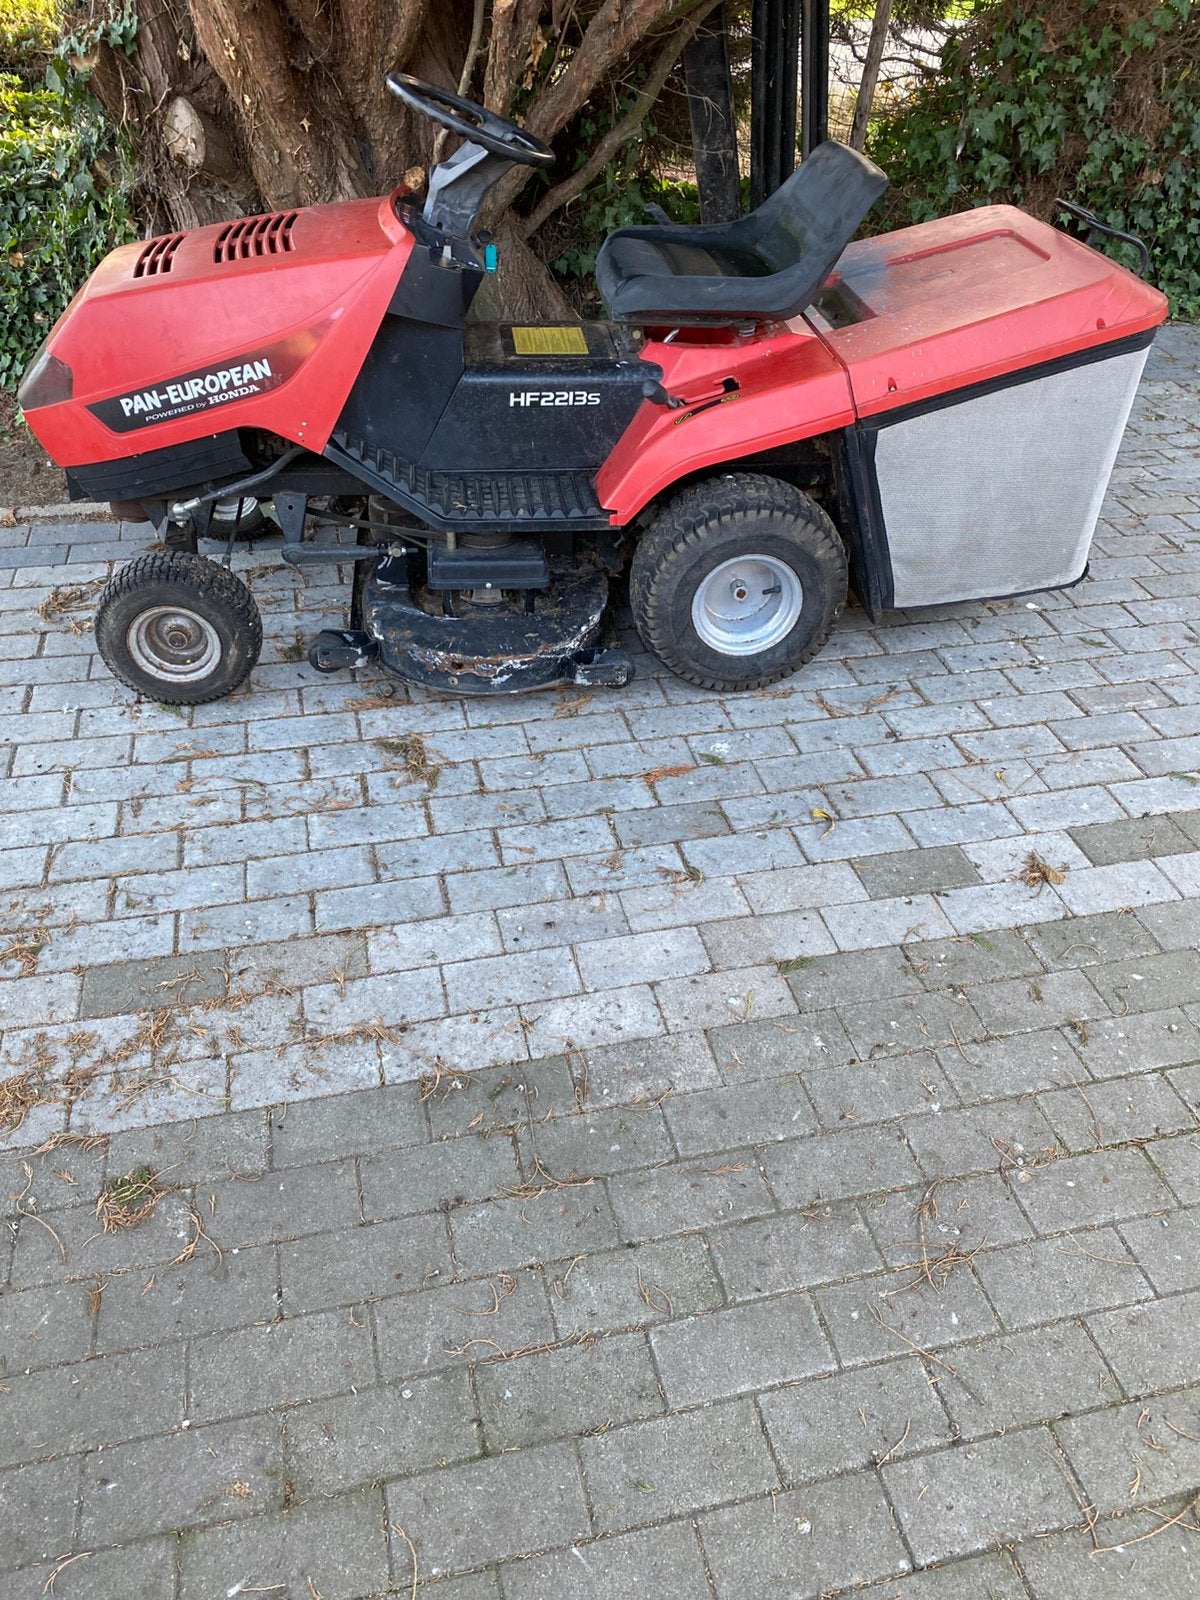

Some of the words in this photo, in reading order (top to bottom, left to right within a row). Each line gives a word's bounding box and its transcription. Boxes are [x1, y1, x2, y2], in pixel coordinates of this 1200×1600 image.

[119, 358, 272, 417] PAN-EUROPEAN
[145, 404, 195, 422] POWERED
[196, 401, 207, 410] by
[207, 384, 260, 405] HONDA
